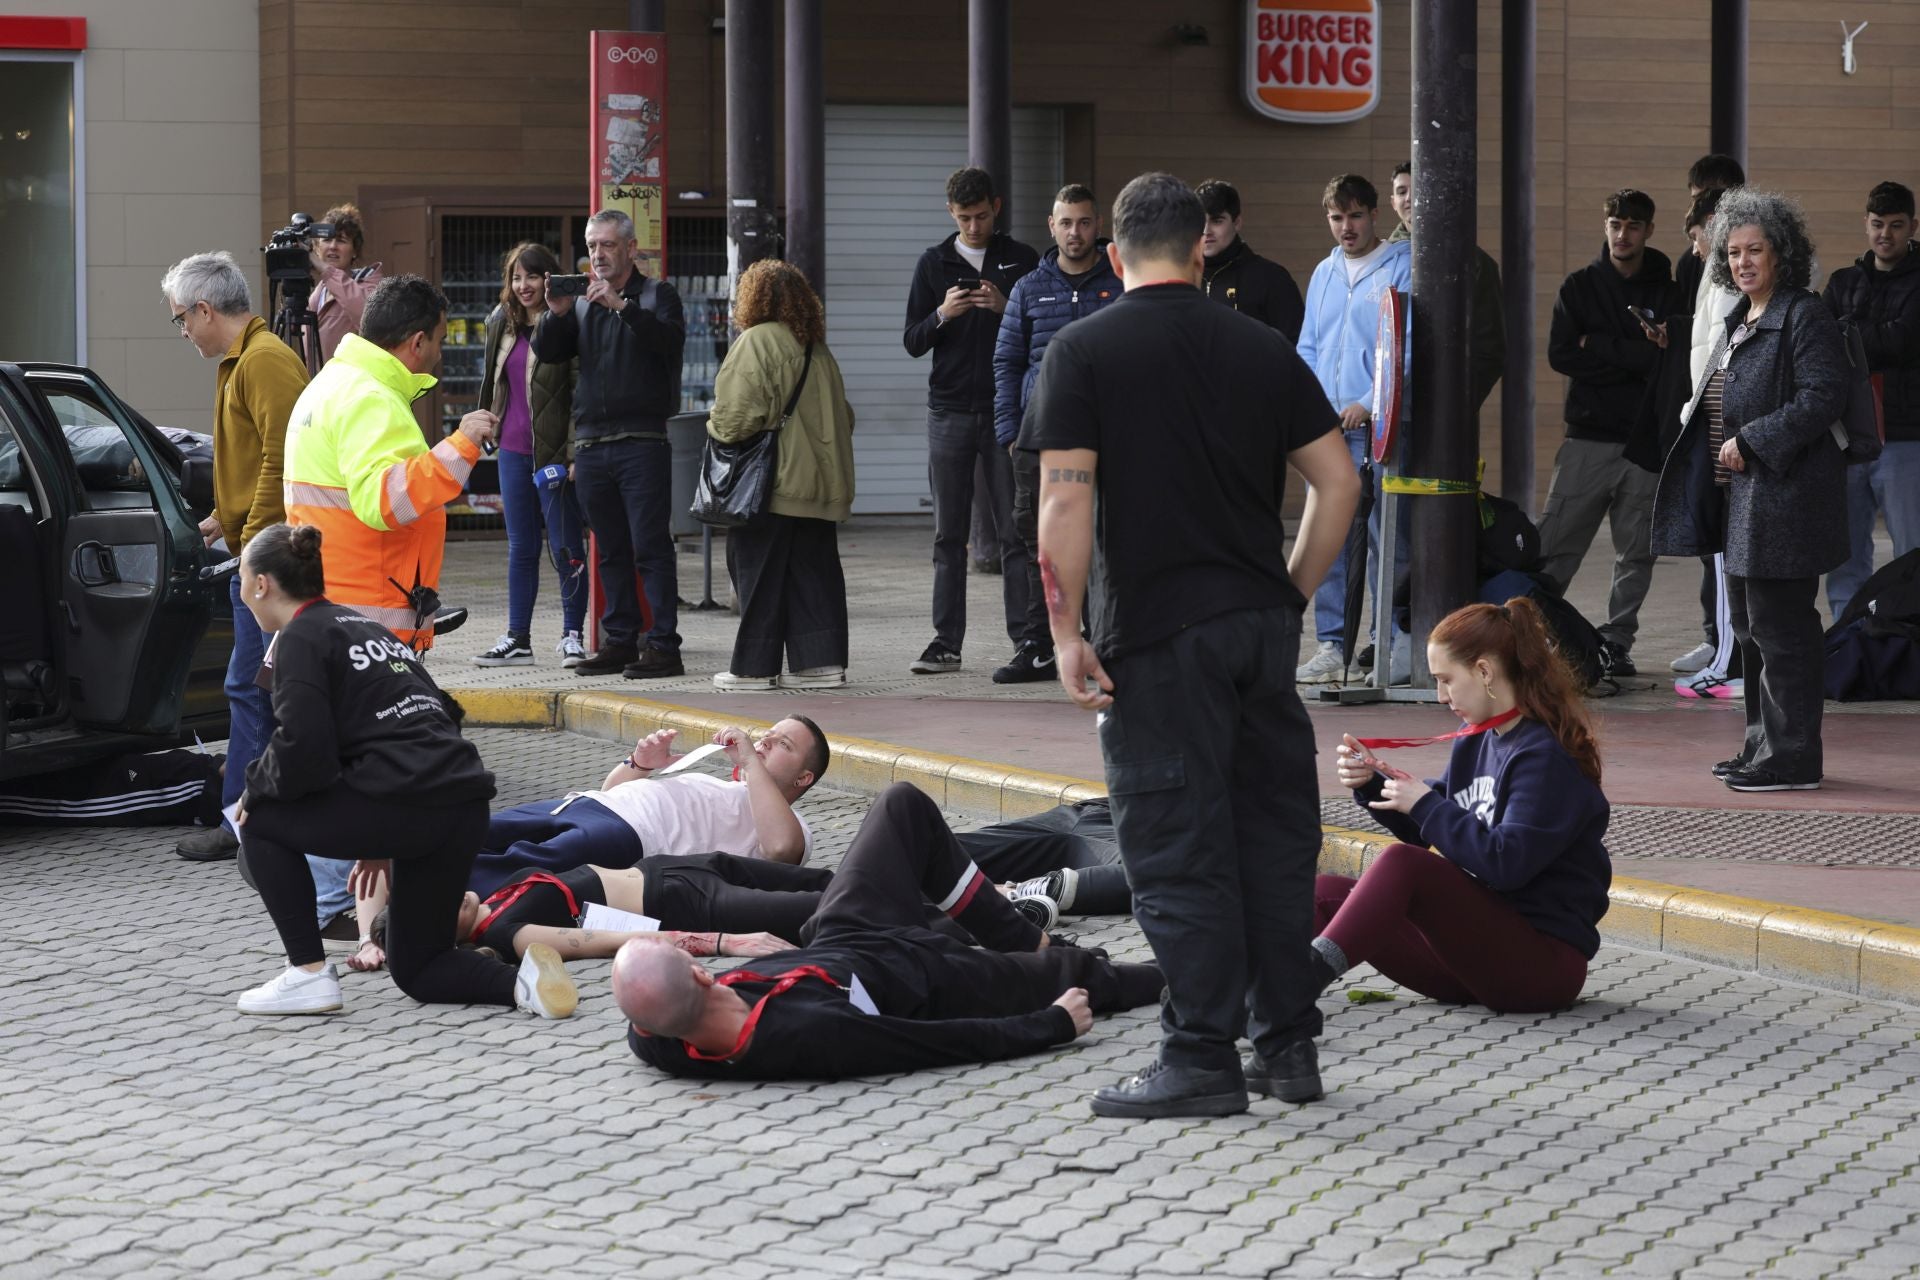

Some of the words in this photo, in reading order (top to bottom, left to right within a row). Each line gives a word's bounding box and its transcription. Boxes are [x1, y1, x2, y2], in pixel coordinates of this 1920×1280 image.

[1257, 13, 1372, 44] BURGER
[1257, 43, 1373, 86] KING
[375, 705, 398, 720] Sorry
[397, 697, 411, 708] but
